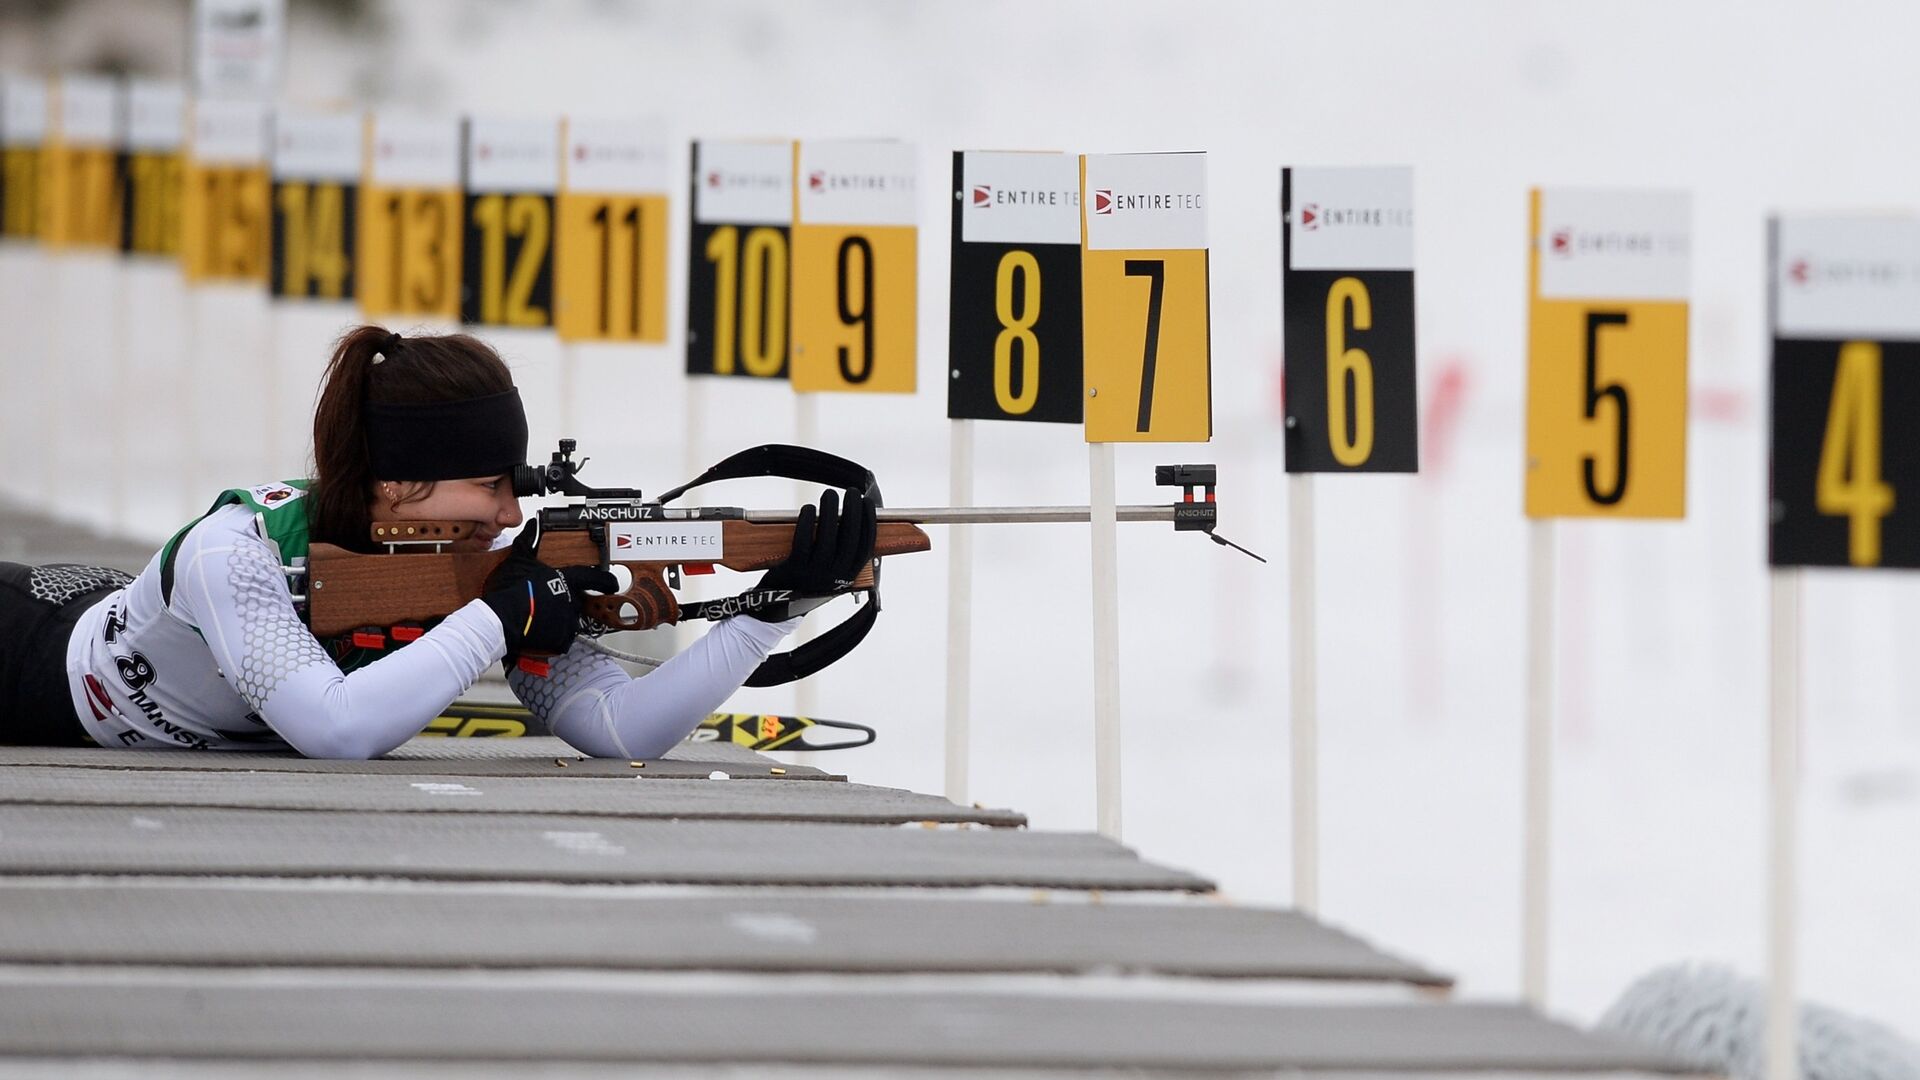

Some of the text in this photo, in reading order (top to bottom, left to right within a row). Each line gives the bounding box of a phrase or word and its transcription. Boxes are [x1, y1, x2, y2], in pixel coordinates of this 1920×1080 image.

[279, 182, 354, 299] 14
[386, 190, 447, 315] 13
[472, 195, 549, 325] 12
[997, 190, 1079, 206] ENTIRE TE
[1117, 194, 1202, 209] ENTIRE TEC
[1323, 209, 1382, 226] ENTIRE
[592, 204, 641, 336] 11
[706, 226, 788, 376] 10
[837, 235, 875, 384] 9
[993, 250, 1041, 415] 8
[1125, 260, 1165, 433] 7
[1325, 276, 1374, 467] 6
[1581, 310, 1630, 507] 5
[1816, 341, 1897, 567] 4
[636, 535, 716, 546] ENTIRE TEC
